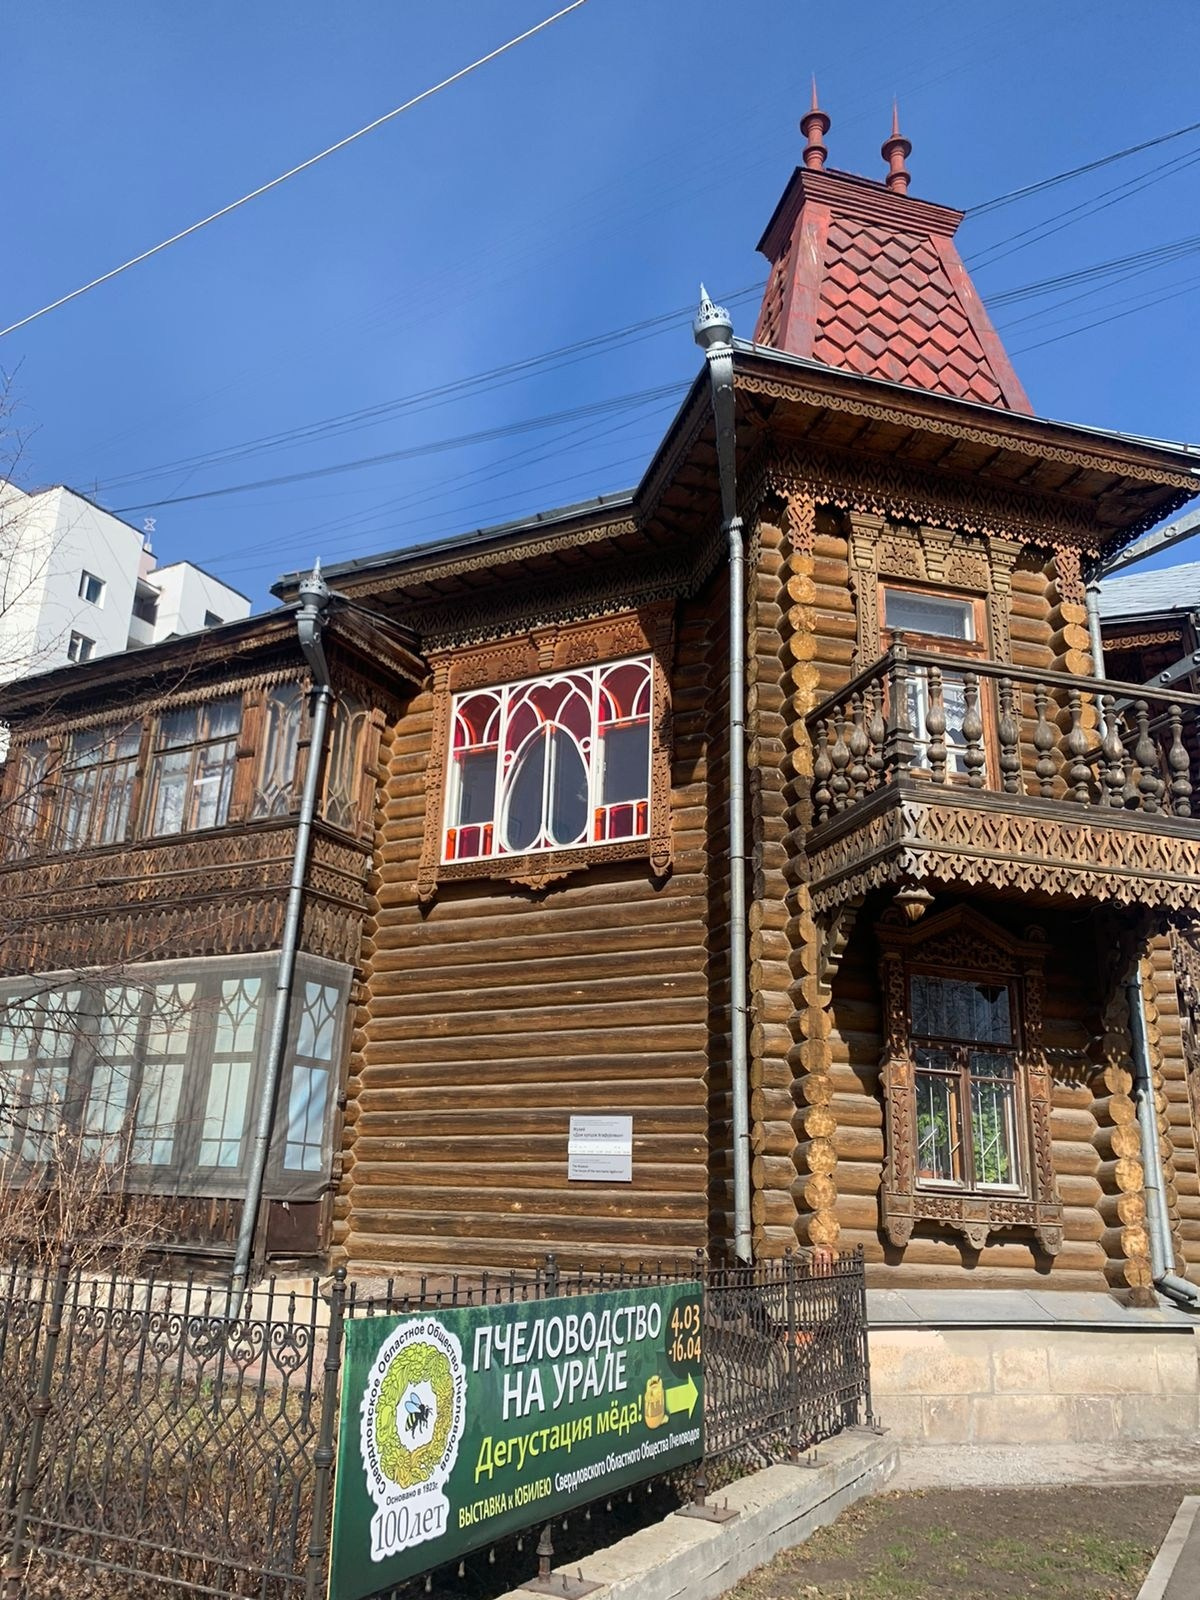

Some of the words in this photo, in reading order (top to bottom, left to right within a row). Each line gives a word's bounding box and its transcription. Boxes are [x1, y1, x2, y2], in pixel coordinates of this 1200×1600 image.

[378, 1325, 425, 1374] Областное
[427, 1323, 459, 1373] Общество
[472, 1302, 661, 1371] ПЧЕЛОВОДСТВО
[669, 1334, 702, 1363] -16.04
[671, 1304, 700, 1337] 4.03
[502, 1367, 545, 1420] НА
[552, 1350, 627, 1410] УРАЛЕ
[366, 1378, 386, 1495] Свердловское
[440, 1374, 463, 1471] Пчеловодов
[474, 1415, 592, 1484] Дегустация
[596, 1394, 643, 1435] мёда!
[459, 1493, 507, 1528] ВЫСТАВКА
[508, 1495, 515, 1510] к
[514, 1476, 553, 1507] ЮБИЛЕЮ
[555, 1460, 605, 1494] Свердловского
[606, 1448, 641, 1473] Областного
[641, 1438, 669, 1460] Общества
[669, 1427, 700, 1450] Пчеловодов
